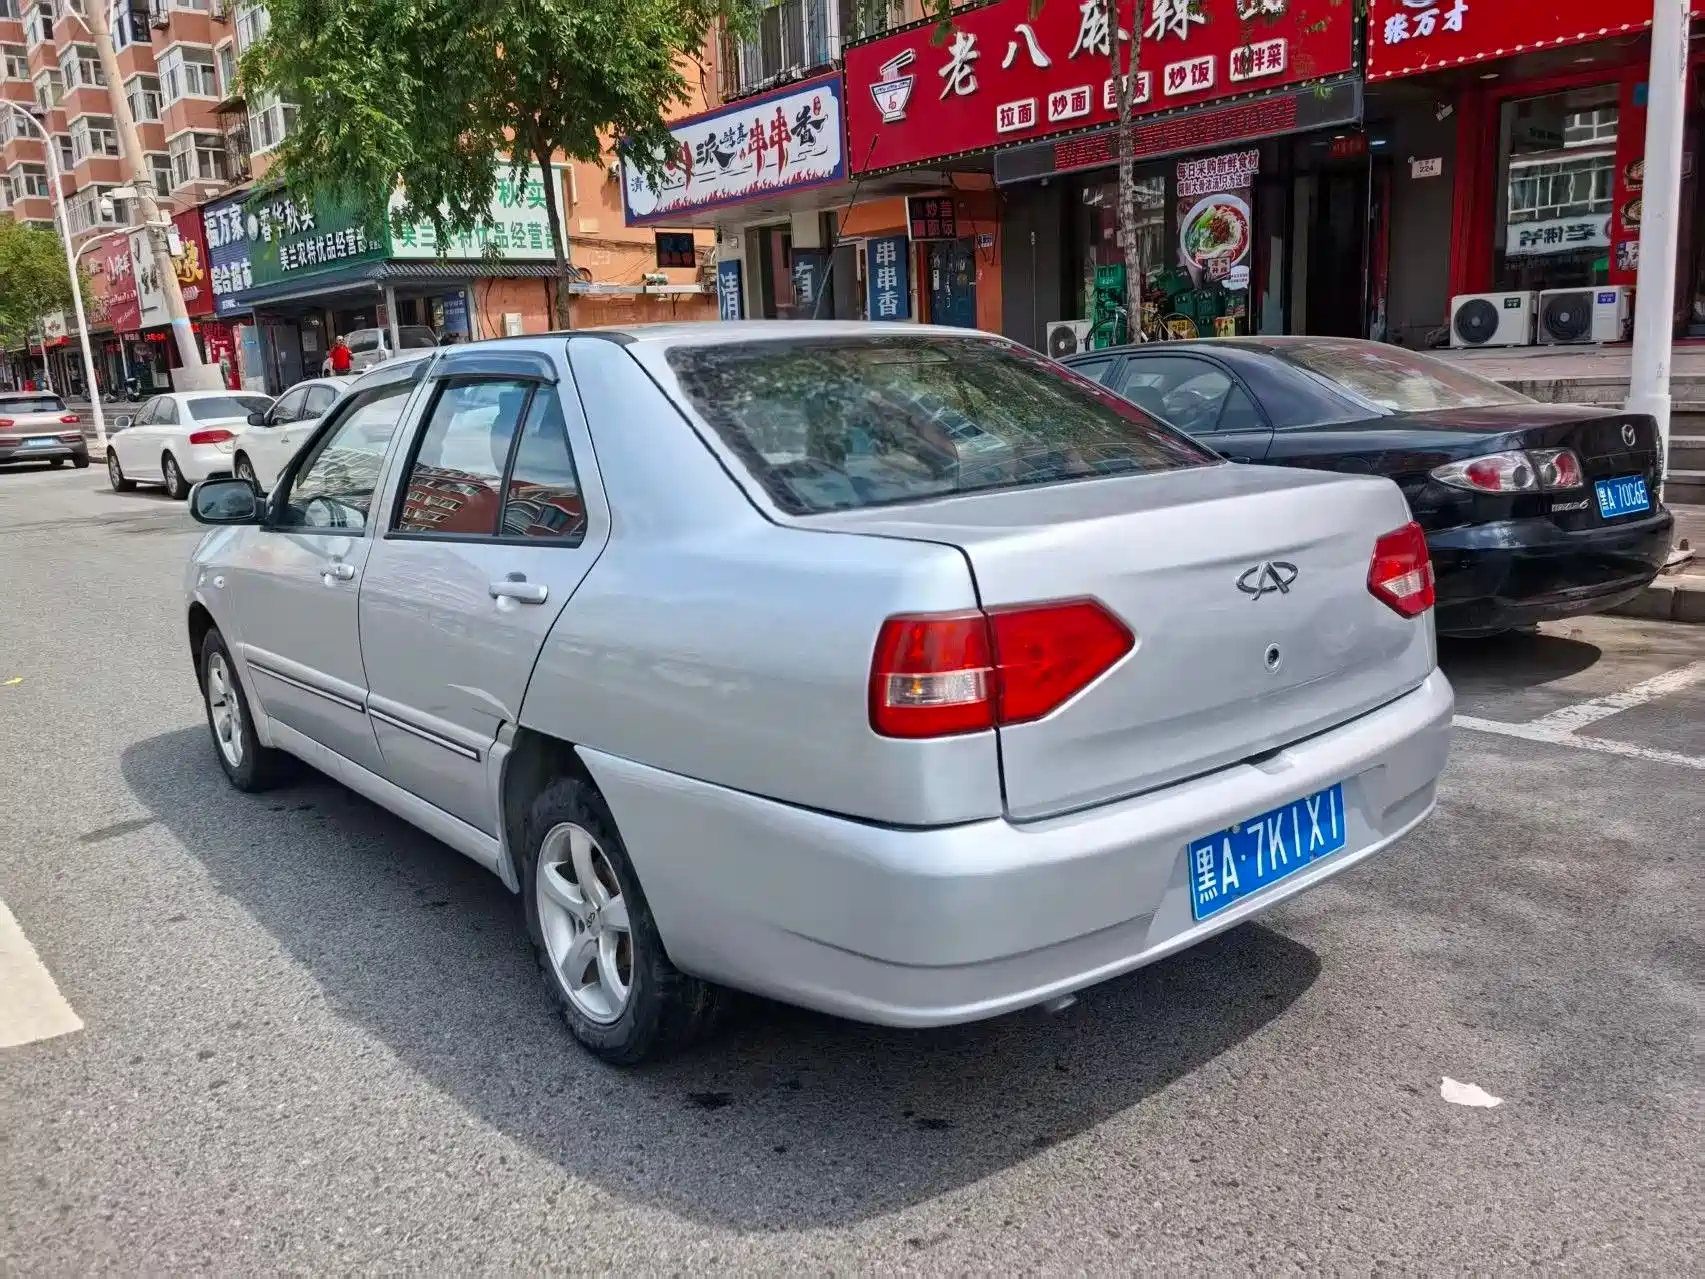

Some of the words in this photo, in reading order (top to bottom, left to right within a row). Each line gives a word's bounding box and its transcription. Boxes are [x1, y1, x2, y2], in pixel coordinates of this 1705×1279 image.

[1383, 0, 1469, 44] 张万才
[1168, 58, 1211, 91] 炒饭
[1000, 102, 1033, 128] 拉面
[1052, 90, 1087, 118] 炒面
[746, 105, 829, 177] 串串香
[1177, 149, 1260, 179] 每日采购新鲜食材
[204, 203, 246, 250] 福万家
[259, 193, 316, 243] 春华秋实
[211, 257, 253, 296] 综合超市
[876, 241, 899, 317] 串串香
[1196, 789, 1338, 904] 黑A·7K1X1
